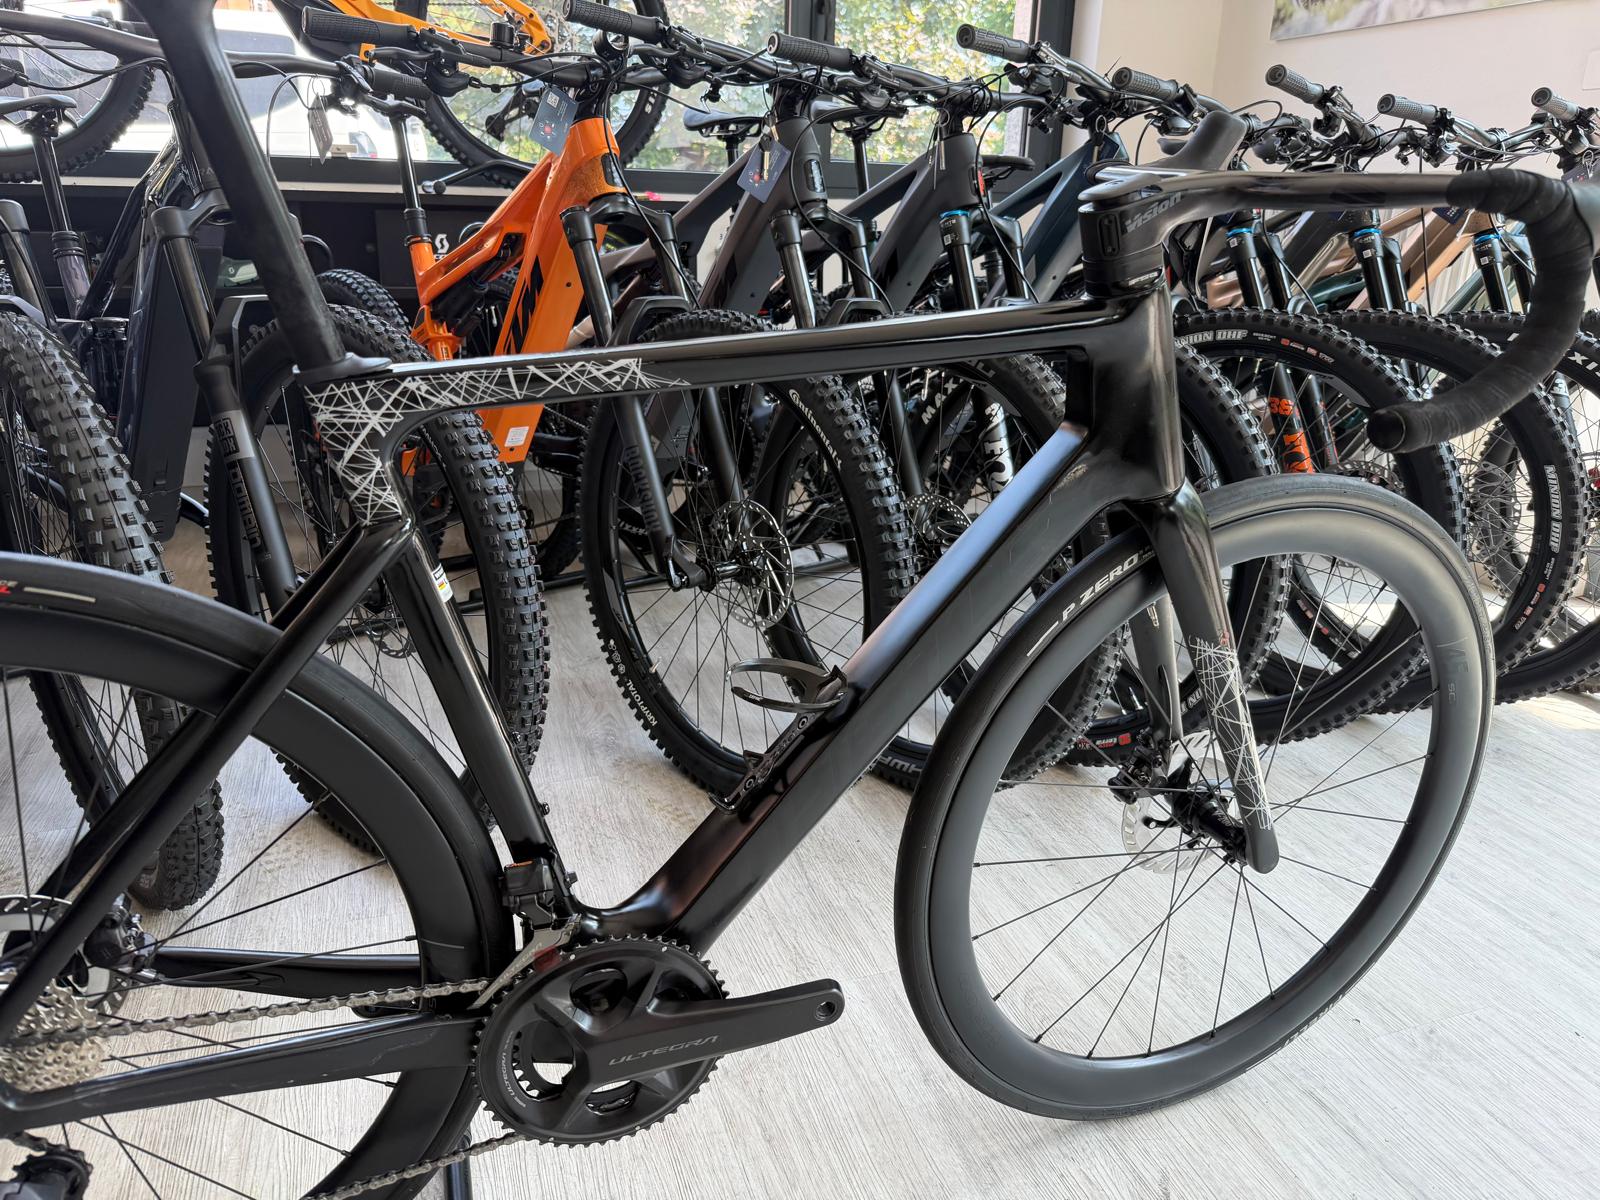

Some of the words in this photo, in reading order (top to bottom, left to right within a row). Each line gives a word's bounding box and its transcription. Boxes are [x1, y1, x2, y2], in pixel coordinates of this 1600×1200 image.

[1125, 191, 1182, 233] Vision
[1215, 329, 1248, 341] DHF
[921, 377, 964, 425] MAX
[788, 389, 837, 460] Continental
[1543, 464, 1563, 520] MINION
[1550, 520, 1563, 554] DHF
[1062, 602, 1076, 621] P
[1079, 552, 1139, 606] ZERO
[626, 679, 658, 727] KRYPTOTAL
[608, 1035, 719, 1066] ULTEGRA
[501, 1052, 516, 1096] ULTEGRA
